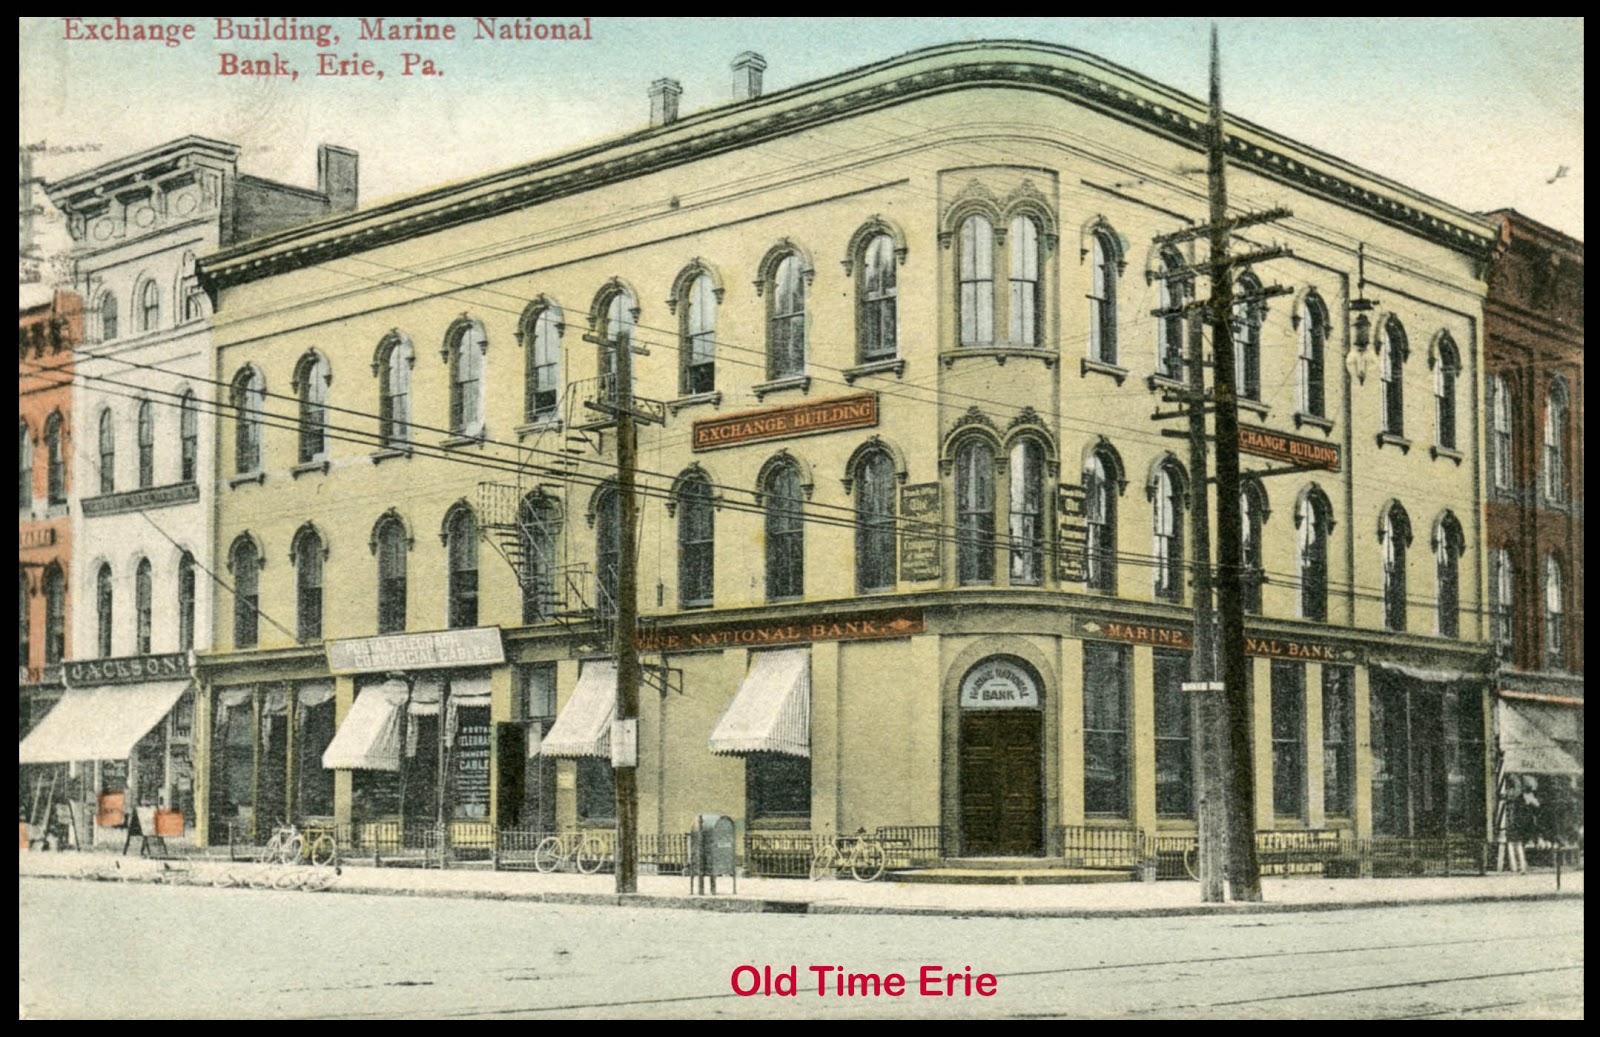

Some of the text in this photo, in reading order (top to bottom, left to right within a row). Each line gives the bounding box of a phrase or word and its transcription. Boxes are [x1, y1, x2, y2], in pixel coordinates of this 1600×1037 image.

[699, 402, 871, 442] EXCHANGE BUILDING
[1289, 440, 1338, 464] BUILDING
[690, 626, 800, 645] NATIONAL
[1107, 623, 1184, 644] MARINE
[982, 689, 1016, 701] BANK
